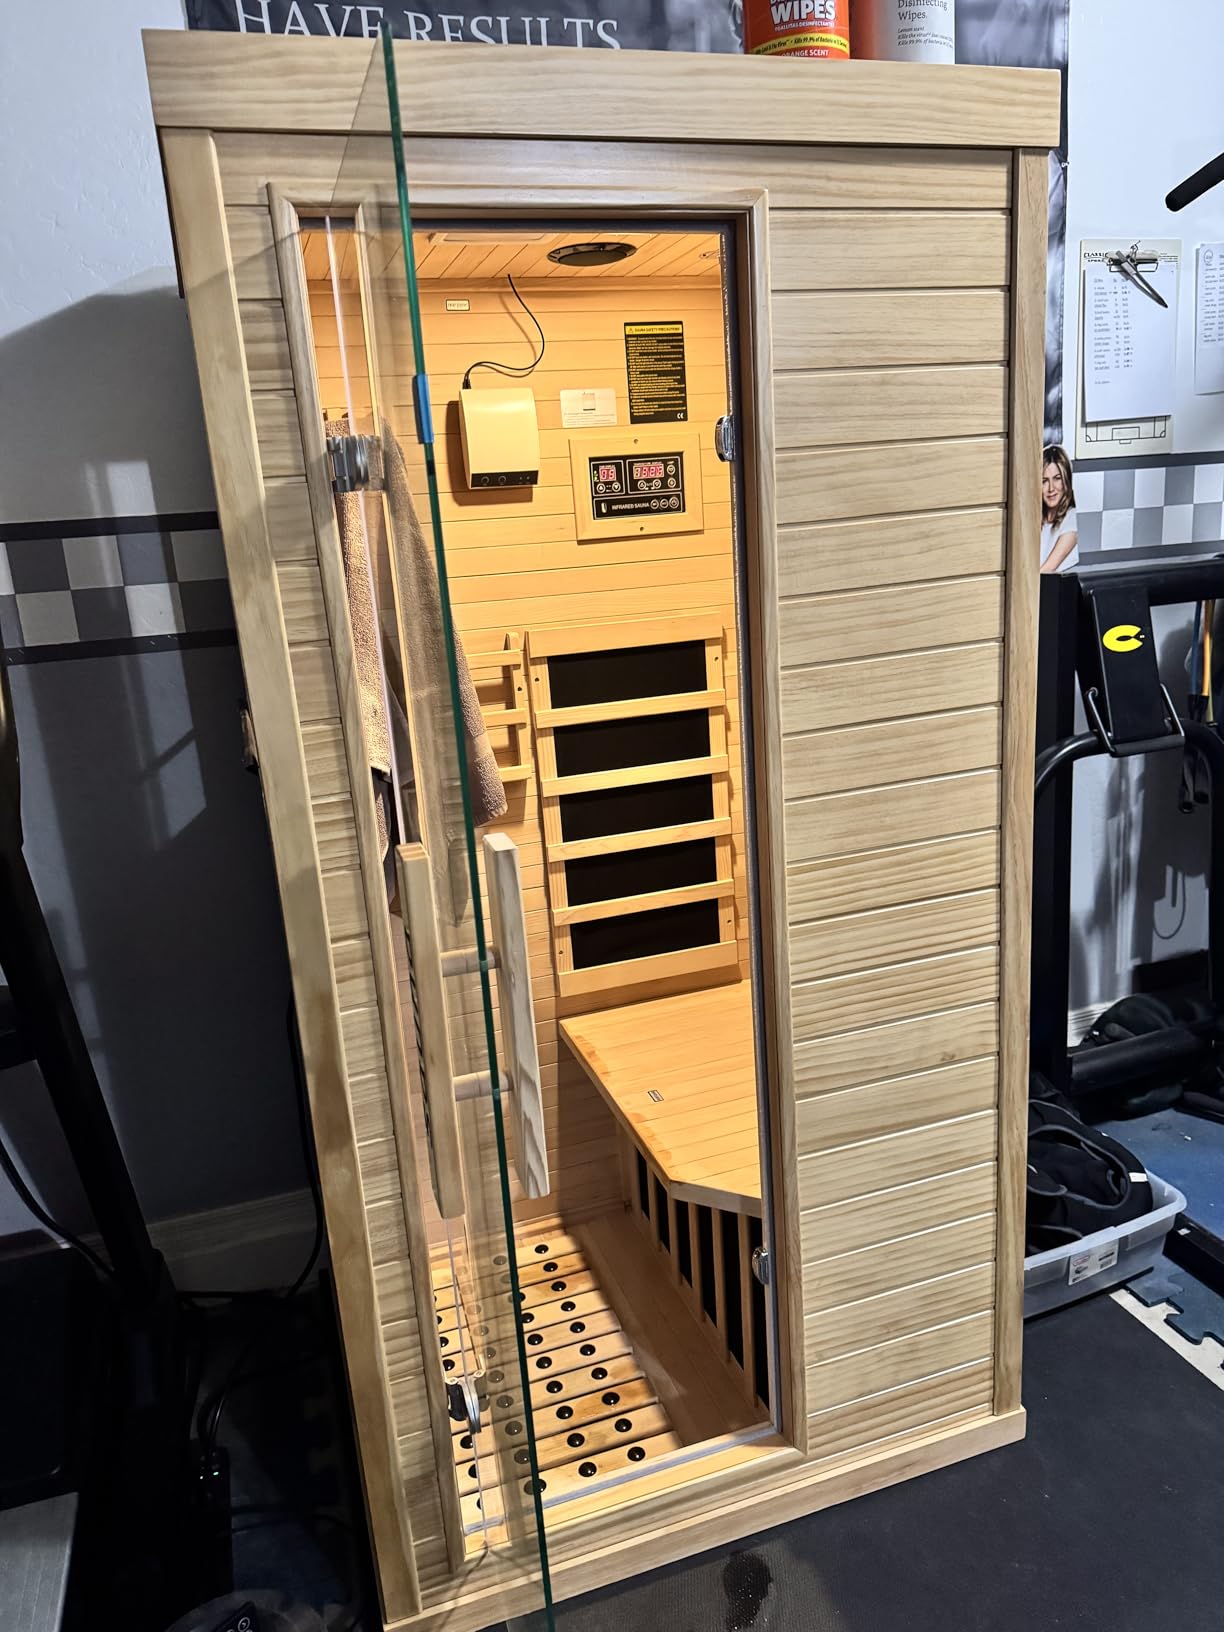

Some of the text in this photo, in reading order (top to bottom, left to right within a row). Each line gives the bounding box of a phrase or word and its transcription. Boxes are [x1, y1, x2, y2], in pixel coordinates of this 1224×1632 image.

[770, 0, 836, 25] WIPES
[898, 0, 948, 11] Disinfecting
[235, 0, 384, 38] HAVE
[897, 11, 927, 21] Wipes.
